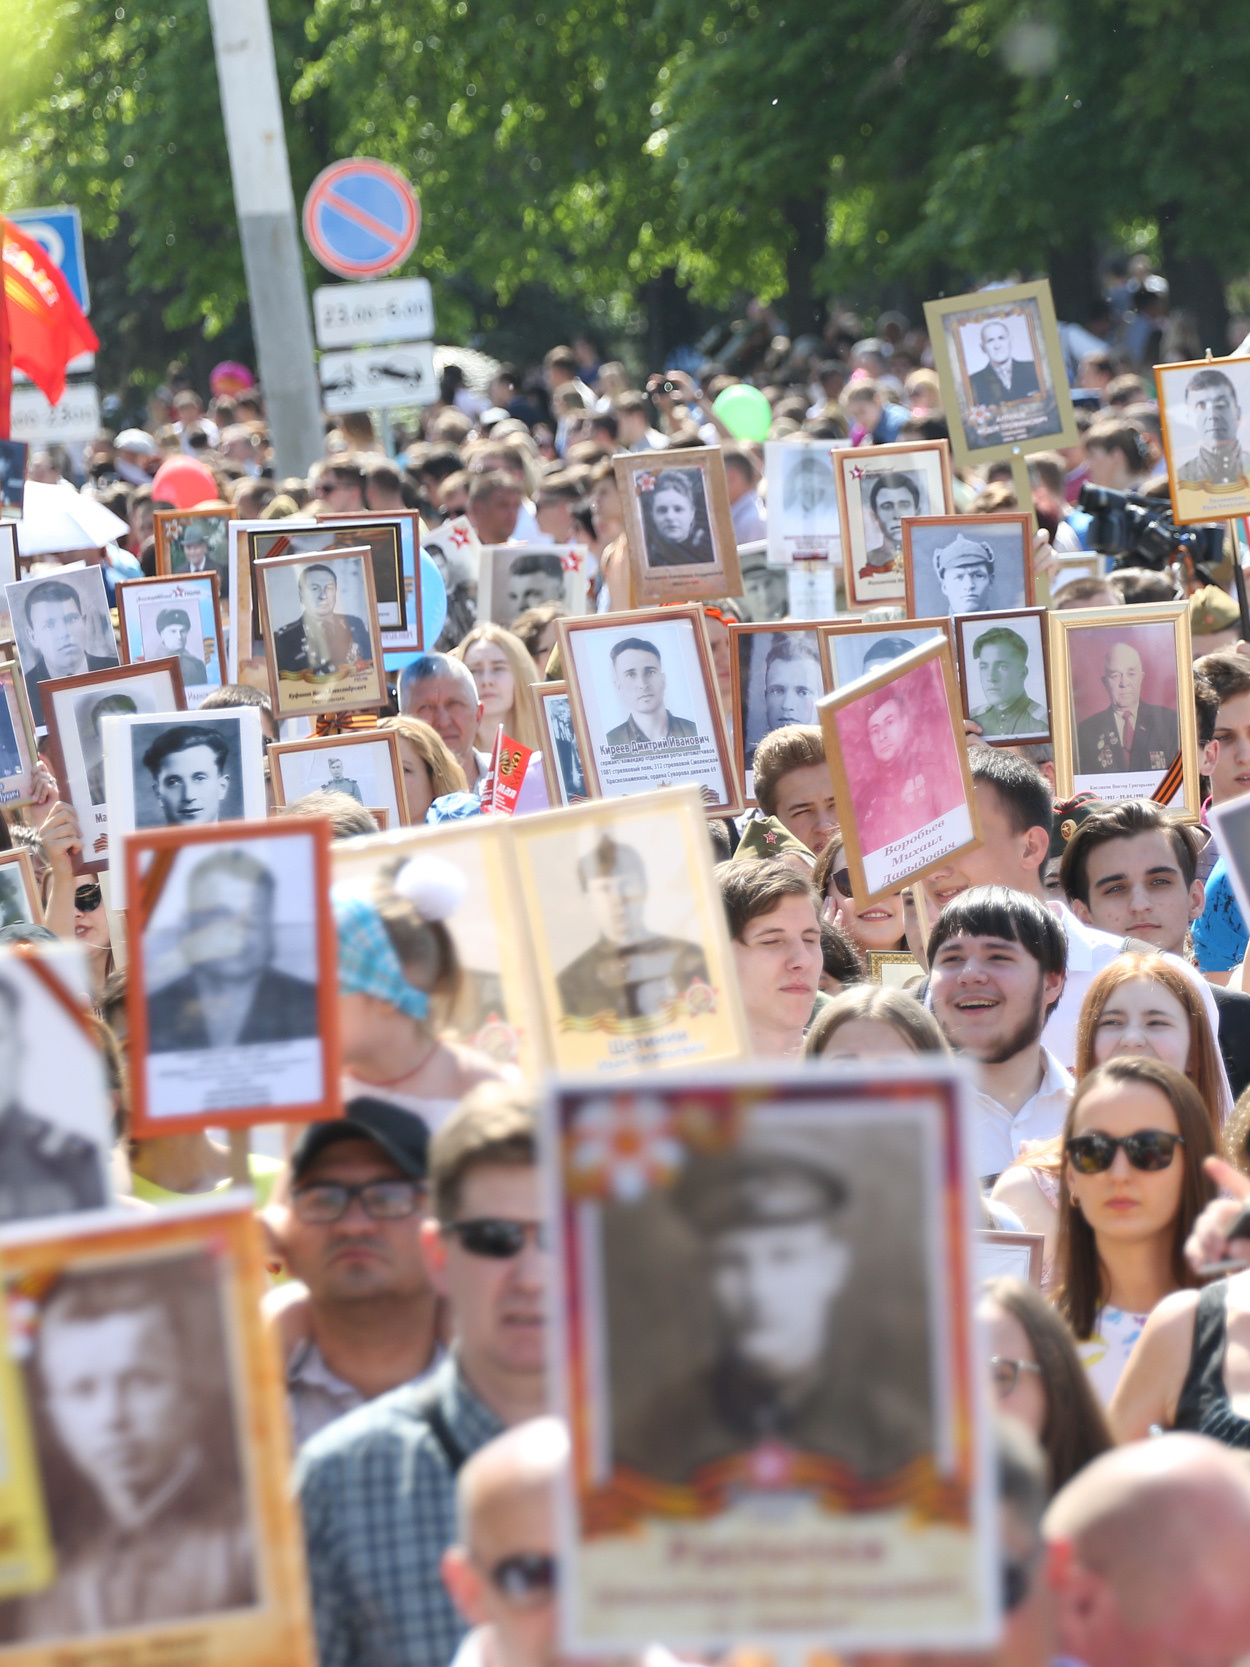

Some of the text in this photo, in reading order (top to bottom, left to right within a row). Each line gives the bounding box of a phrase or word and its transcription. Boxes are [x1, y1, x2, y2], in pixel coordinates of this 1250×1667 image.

[600, 735, 710, 756] Киреев Дмитрий Иванович
[668, 770, 690, 778] Суворова
[884, 820, 945, 857] Воробьев
[891, 835, 943, 867] Михаил
[881, 842, 956, 888] Давыдович
